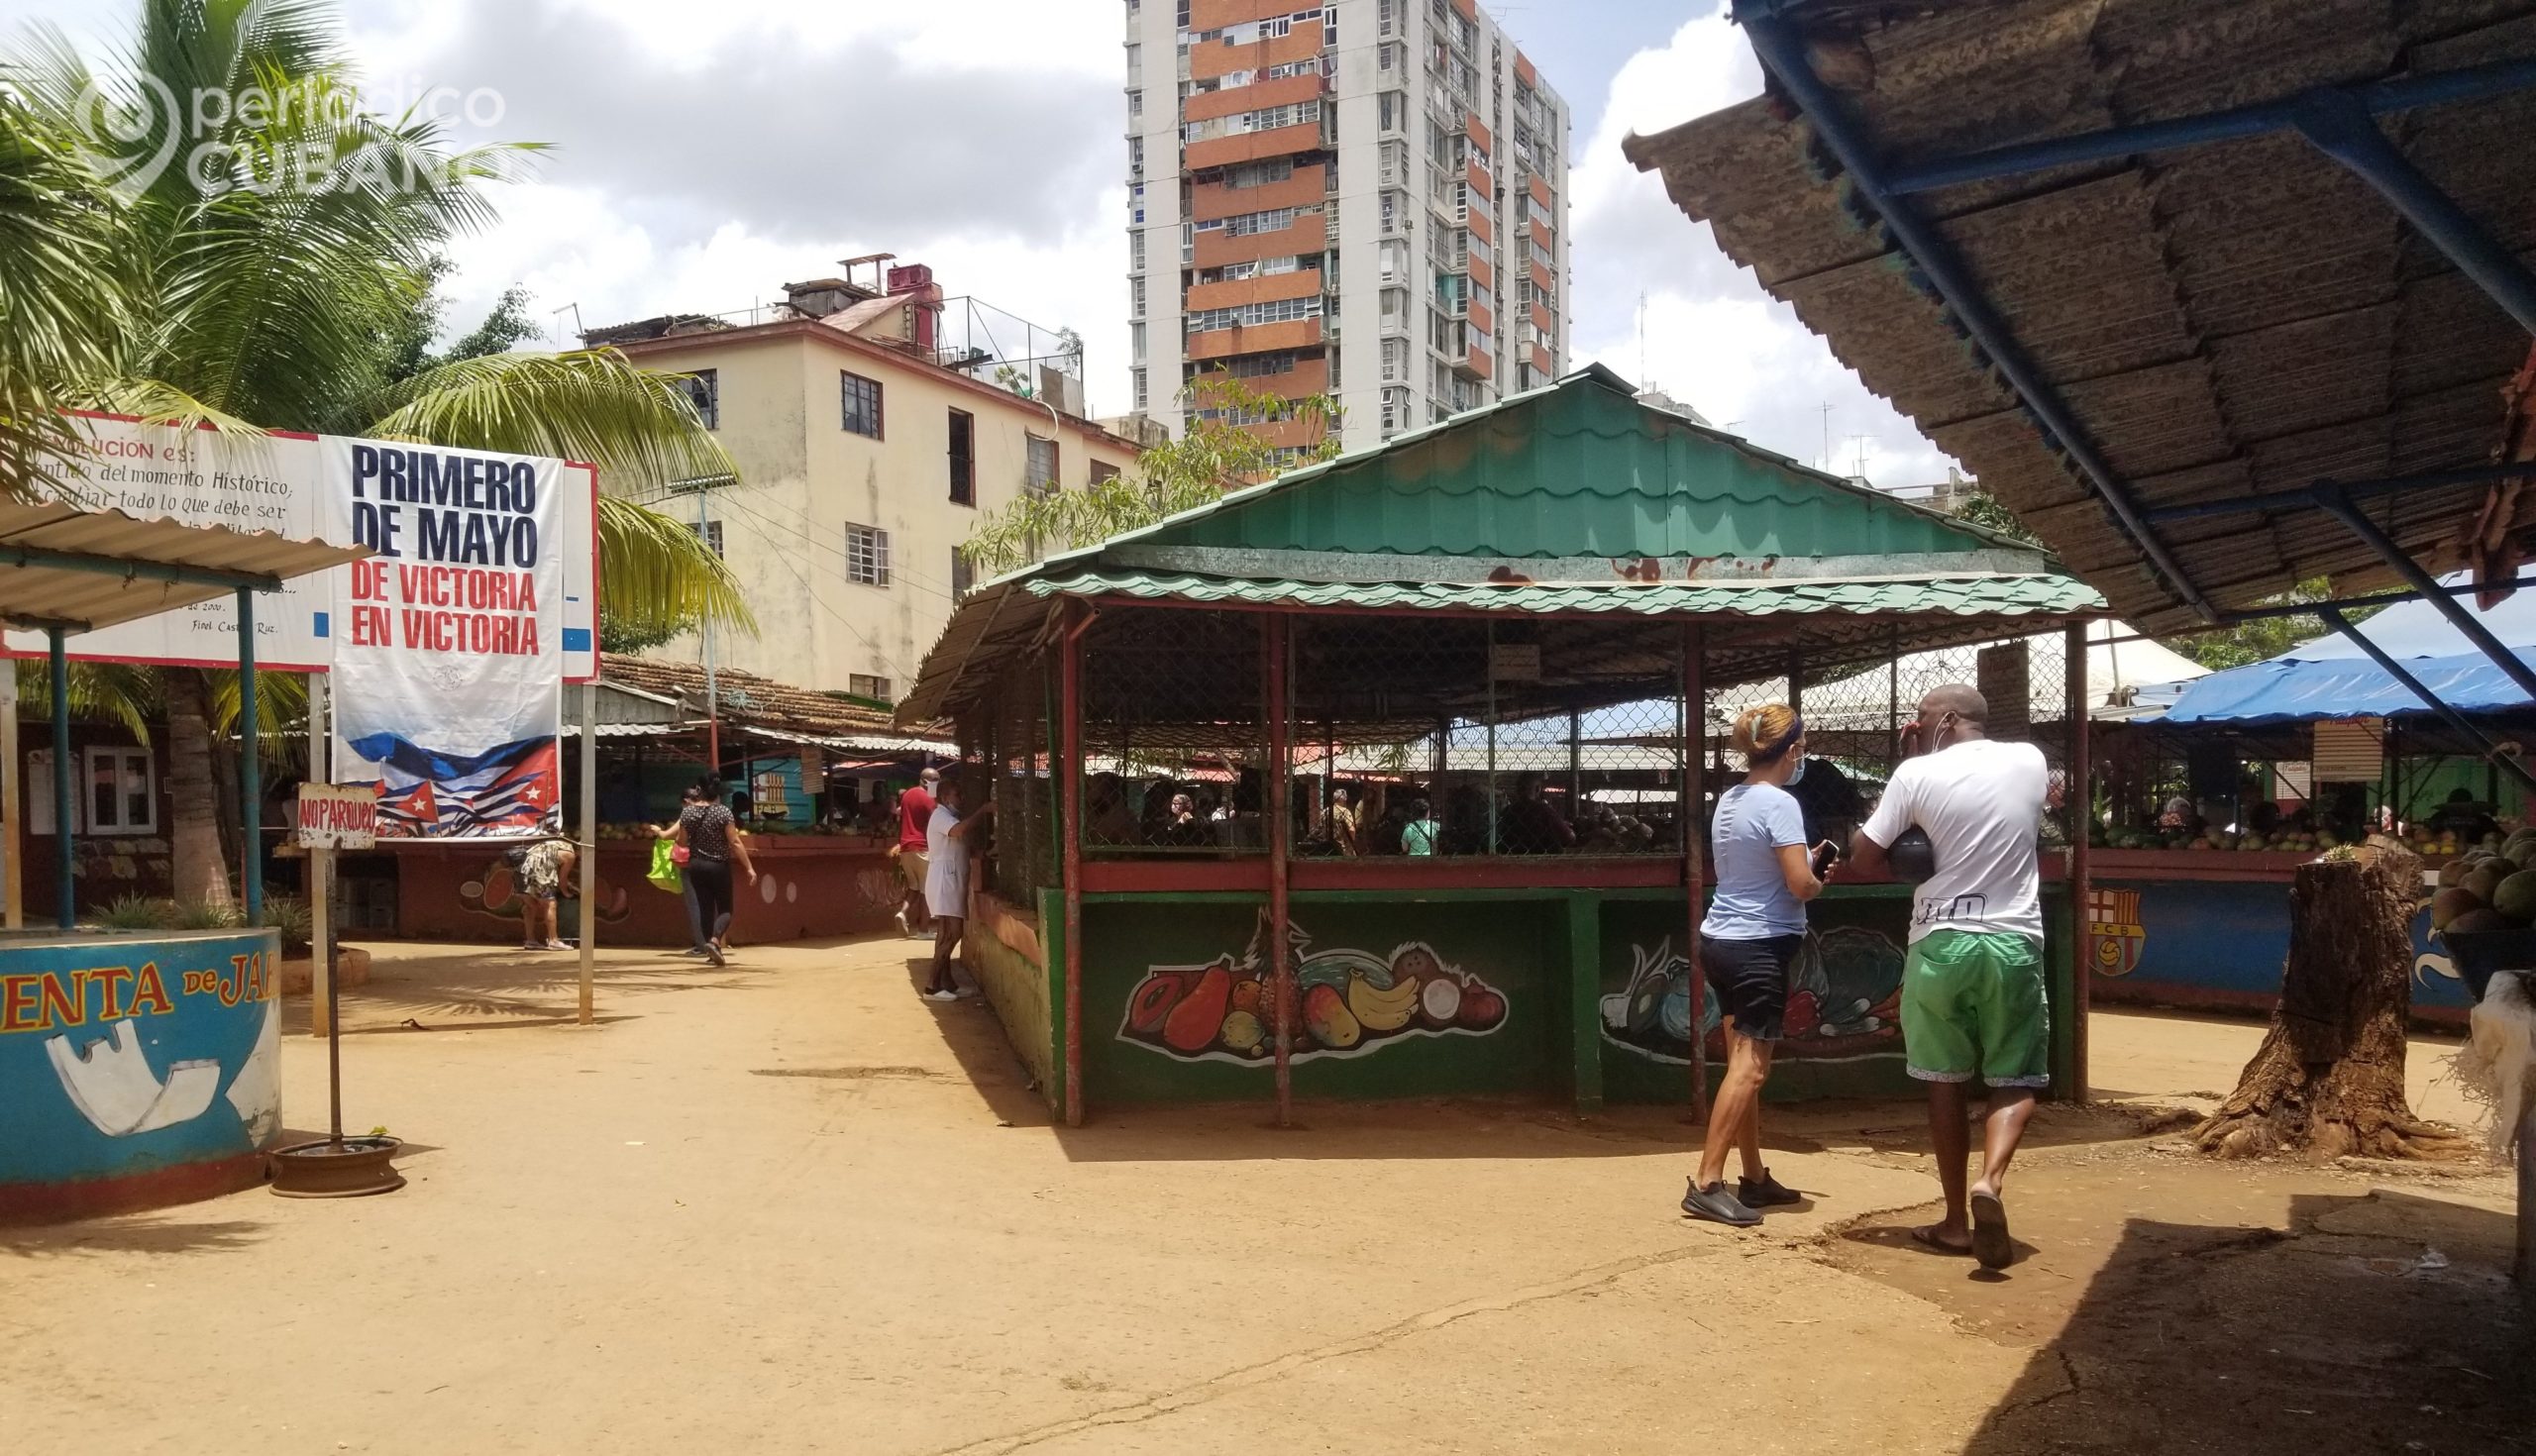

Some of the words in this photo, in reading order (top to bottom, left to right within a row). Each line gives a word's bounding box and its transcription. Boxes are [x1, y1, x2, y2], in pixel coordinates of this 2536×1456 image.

[100, 464, 127, 482] del
[131, 468, 204, 487] momento
[352, 444, 536, 515] PRIMERO
[120, 489, 155, 509] todo
[160, 493, 176, 511] lo
[214, 499, 251, 516] debe
[257, 505, 286, 519] ser
[352, 501, 401, 558] DE
[418, 507, 538, 569] MAYO
[352, 560, 388, 602] DE
[398, 563, 537, 612] VICTORIA
[352, 605, 392, 647] EN
[401, 608, 540, 656] VICTORIA
[0, 961, 174, 1034] ENTA
